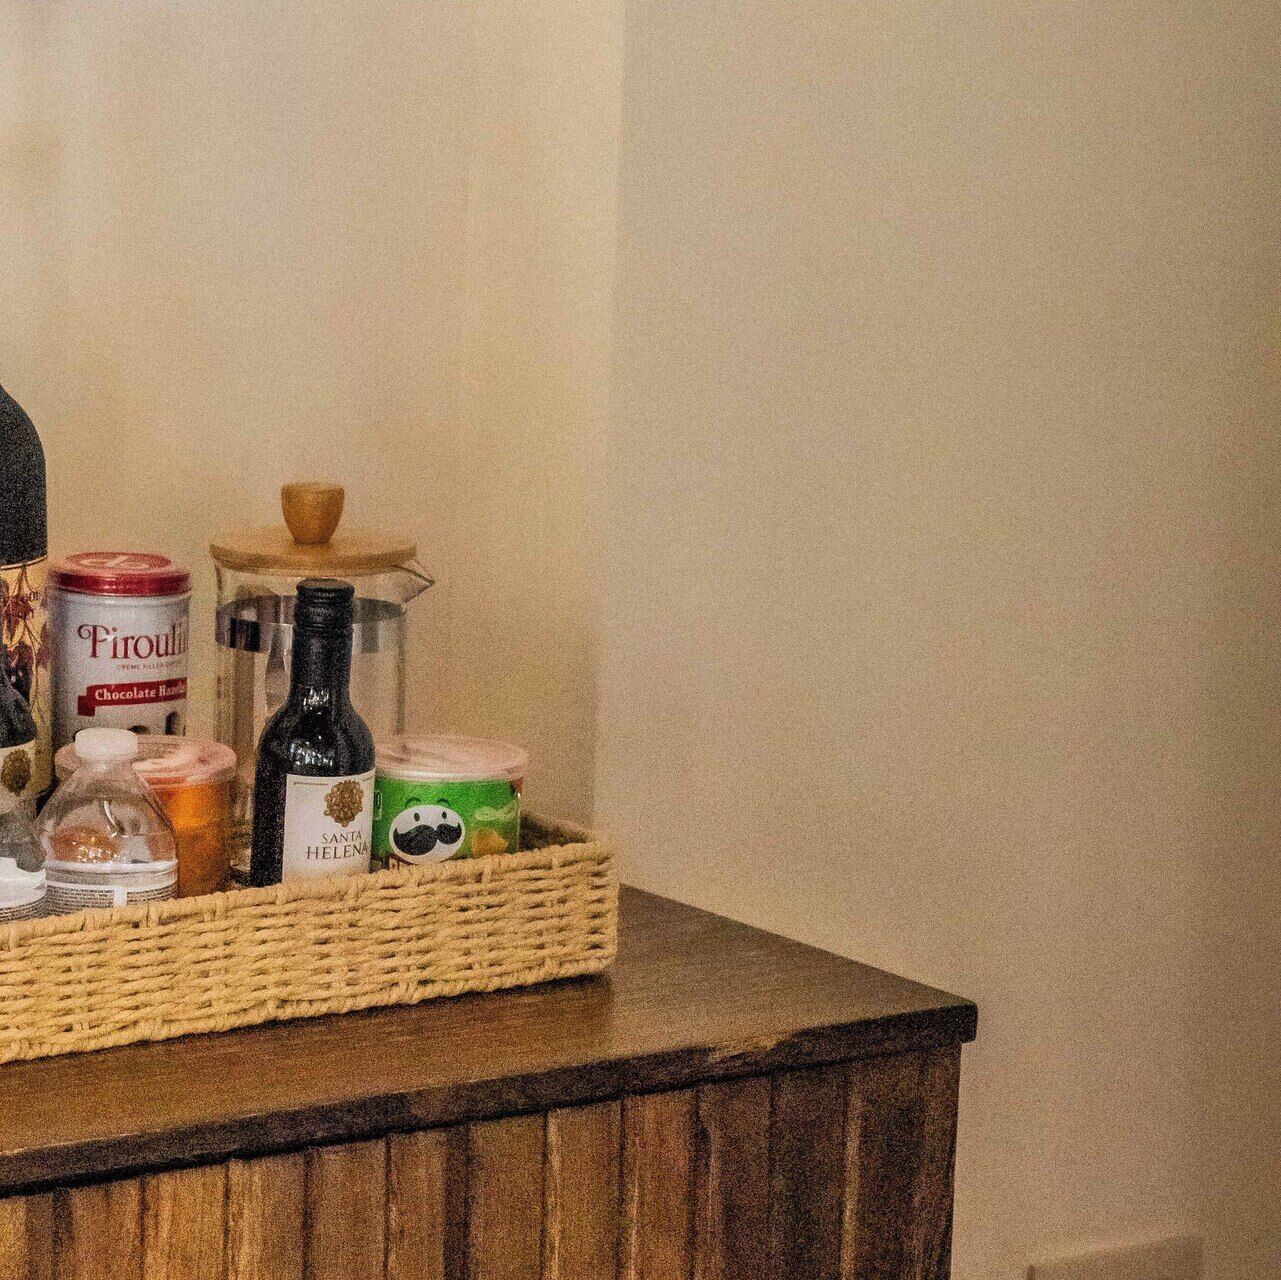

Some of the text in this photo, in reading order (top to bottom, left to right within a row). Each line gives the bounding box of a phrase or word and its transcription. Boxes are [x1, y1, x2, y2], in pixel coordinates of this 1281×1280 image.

[95, 686, 156, 701] Chocolate
[322, 831, 362, 844] SANTA
[306, 841, 368, 859] HELENA
